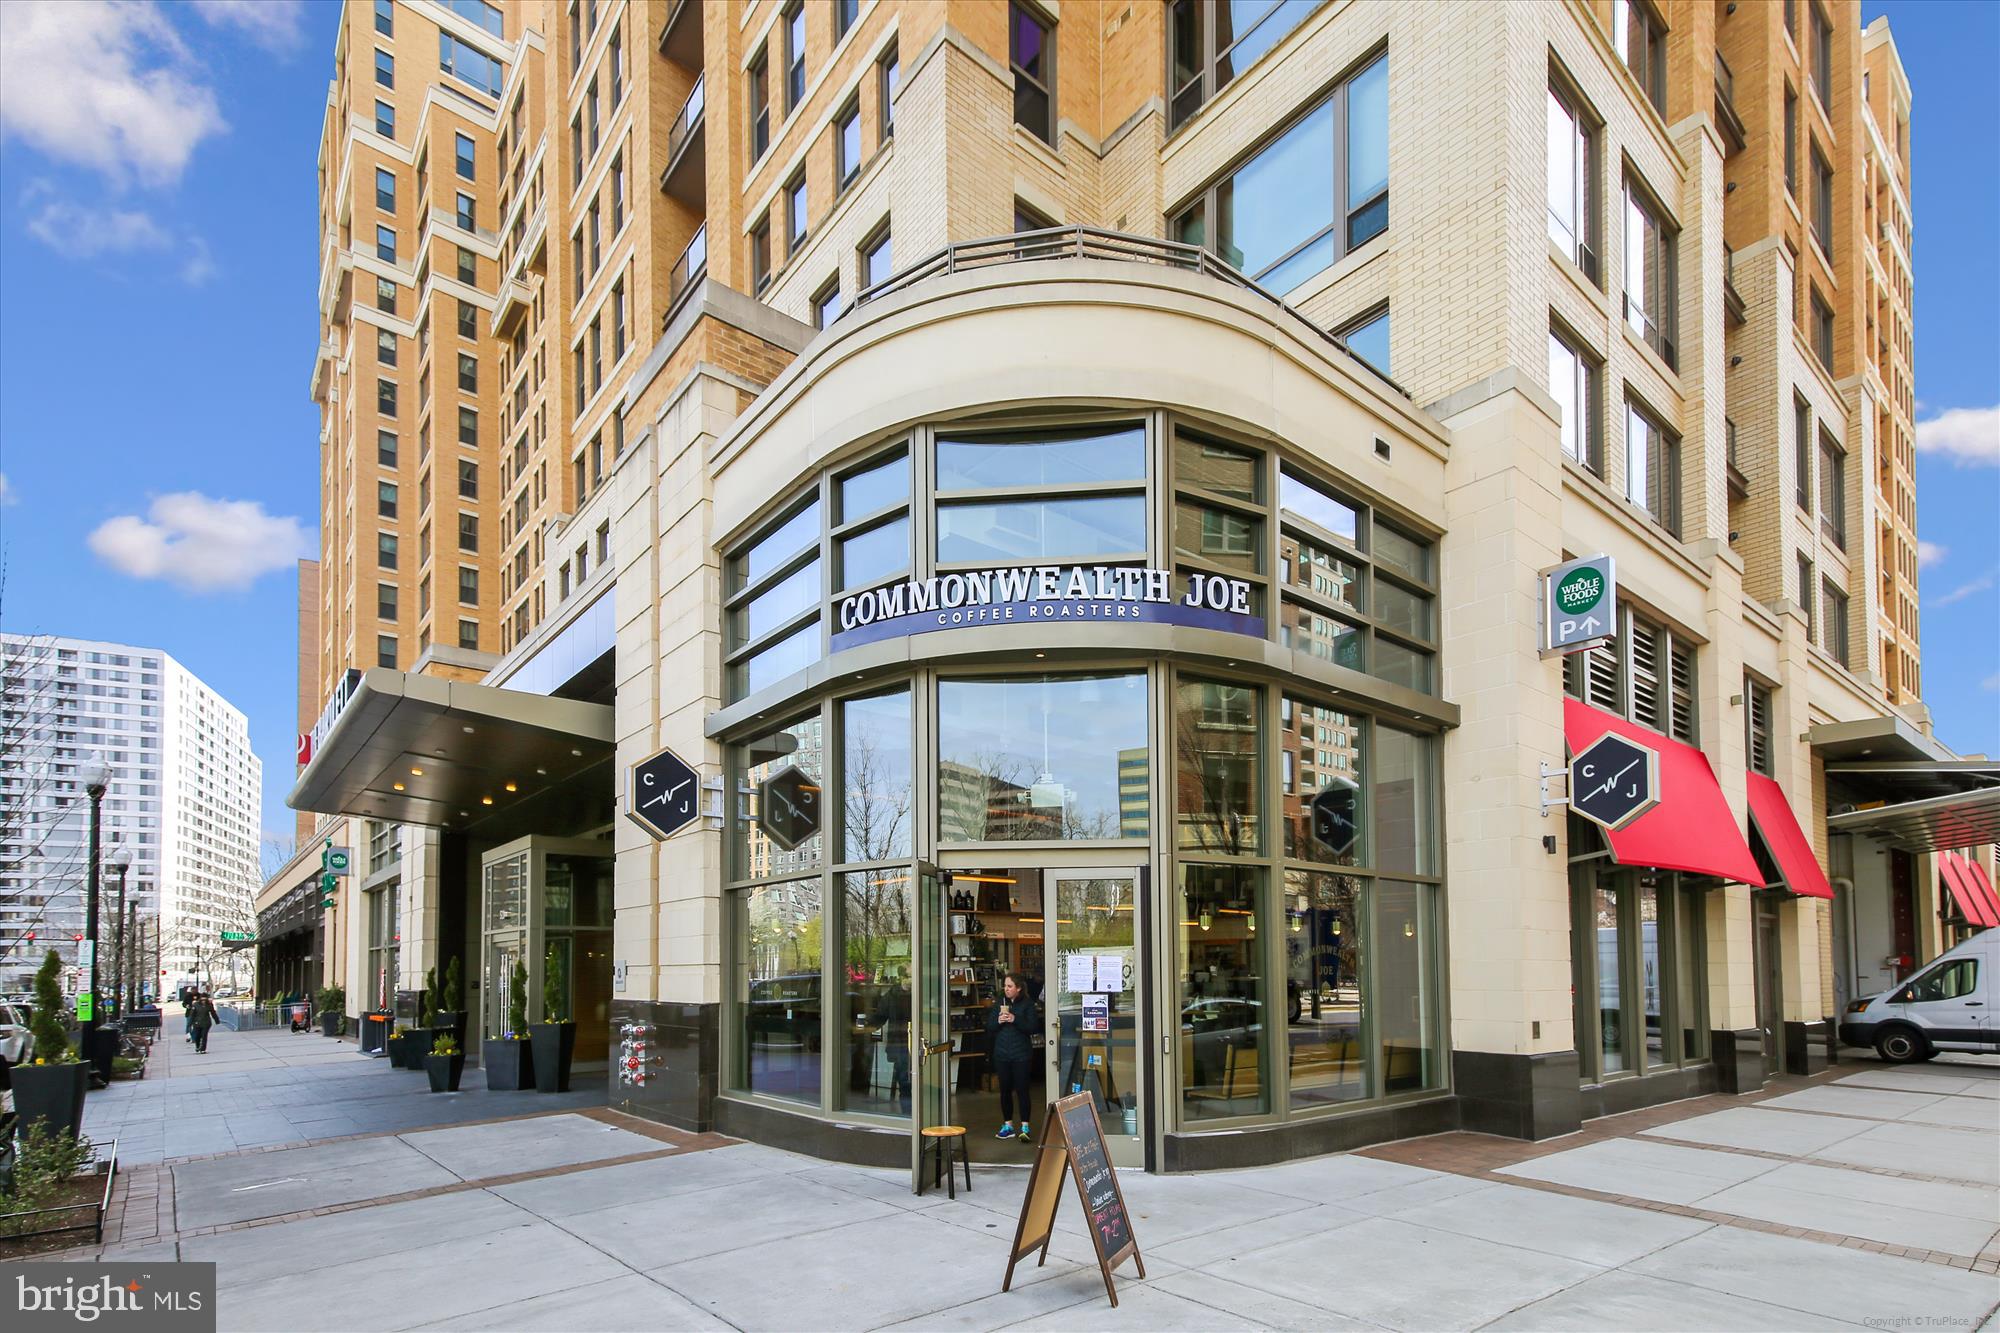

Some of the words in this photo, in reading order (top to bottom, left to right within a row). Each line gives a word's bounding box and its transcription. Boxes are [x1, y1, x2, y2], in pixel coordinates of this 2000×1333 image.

[1561, 577, 1600, 595] WHOLE
[1563, 587, 1599, 603] FOODS
[840, 566, 1170, 630] COMMONWEALTH
[1186, 573, 1250, 615] JOE
[1567, 597, 1594, 607] MARKET
[937, 606, 1013, 625] COFFEE
[1029, 604, 1140, 617] ROASTERS
[1560, 620, 1577, 642] P
